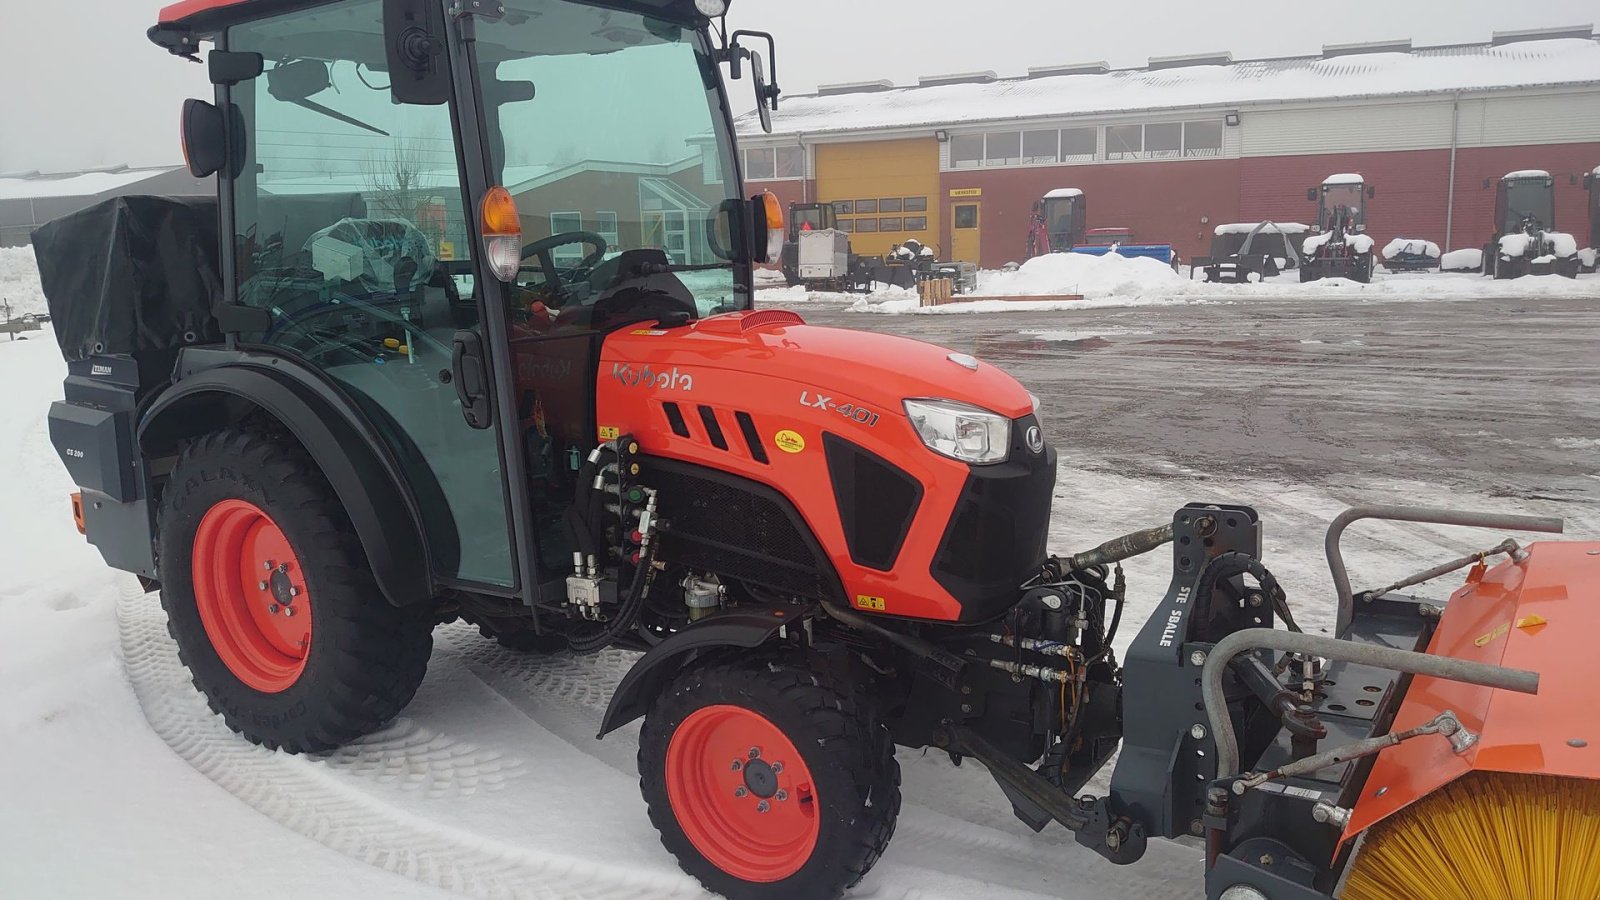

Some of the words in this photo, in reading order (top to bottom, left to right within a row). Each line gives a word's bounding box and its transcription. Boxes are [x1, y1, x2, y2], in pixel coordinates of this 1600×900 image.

[611, 363, 694, 392] Kubota
[799, 390, 880, 428] LX-401
[74, 450, 84, 459] 200
[1160, 610, 1182, 647] SBALLE
